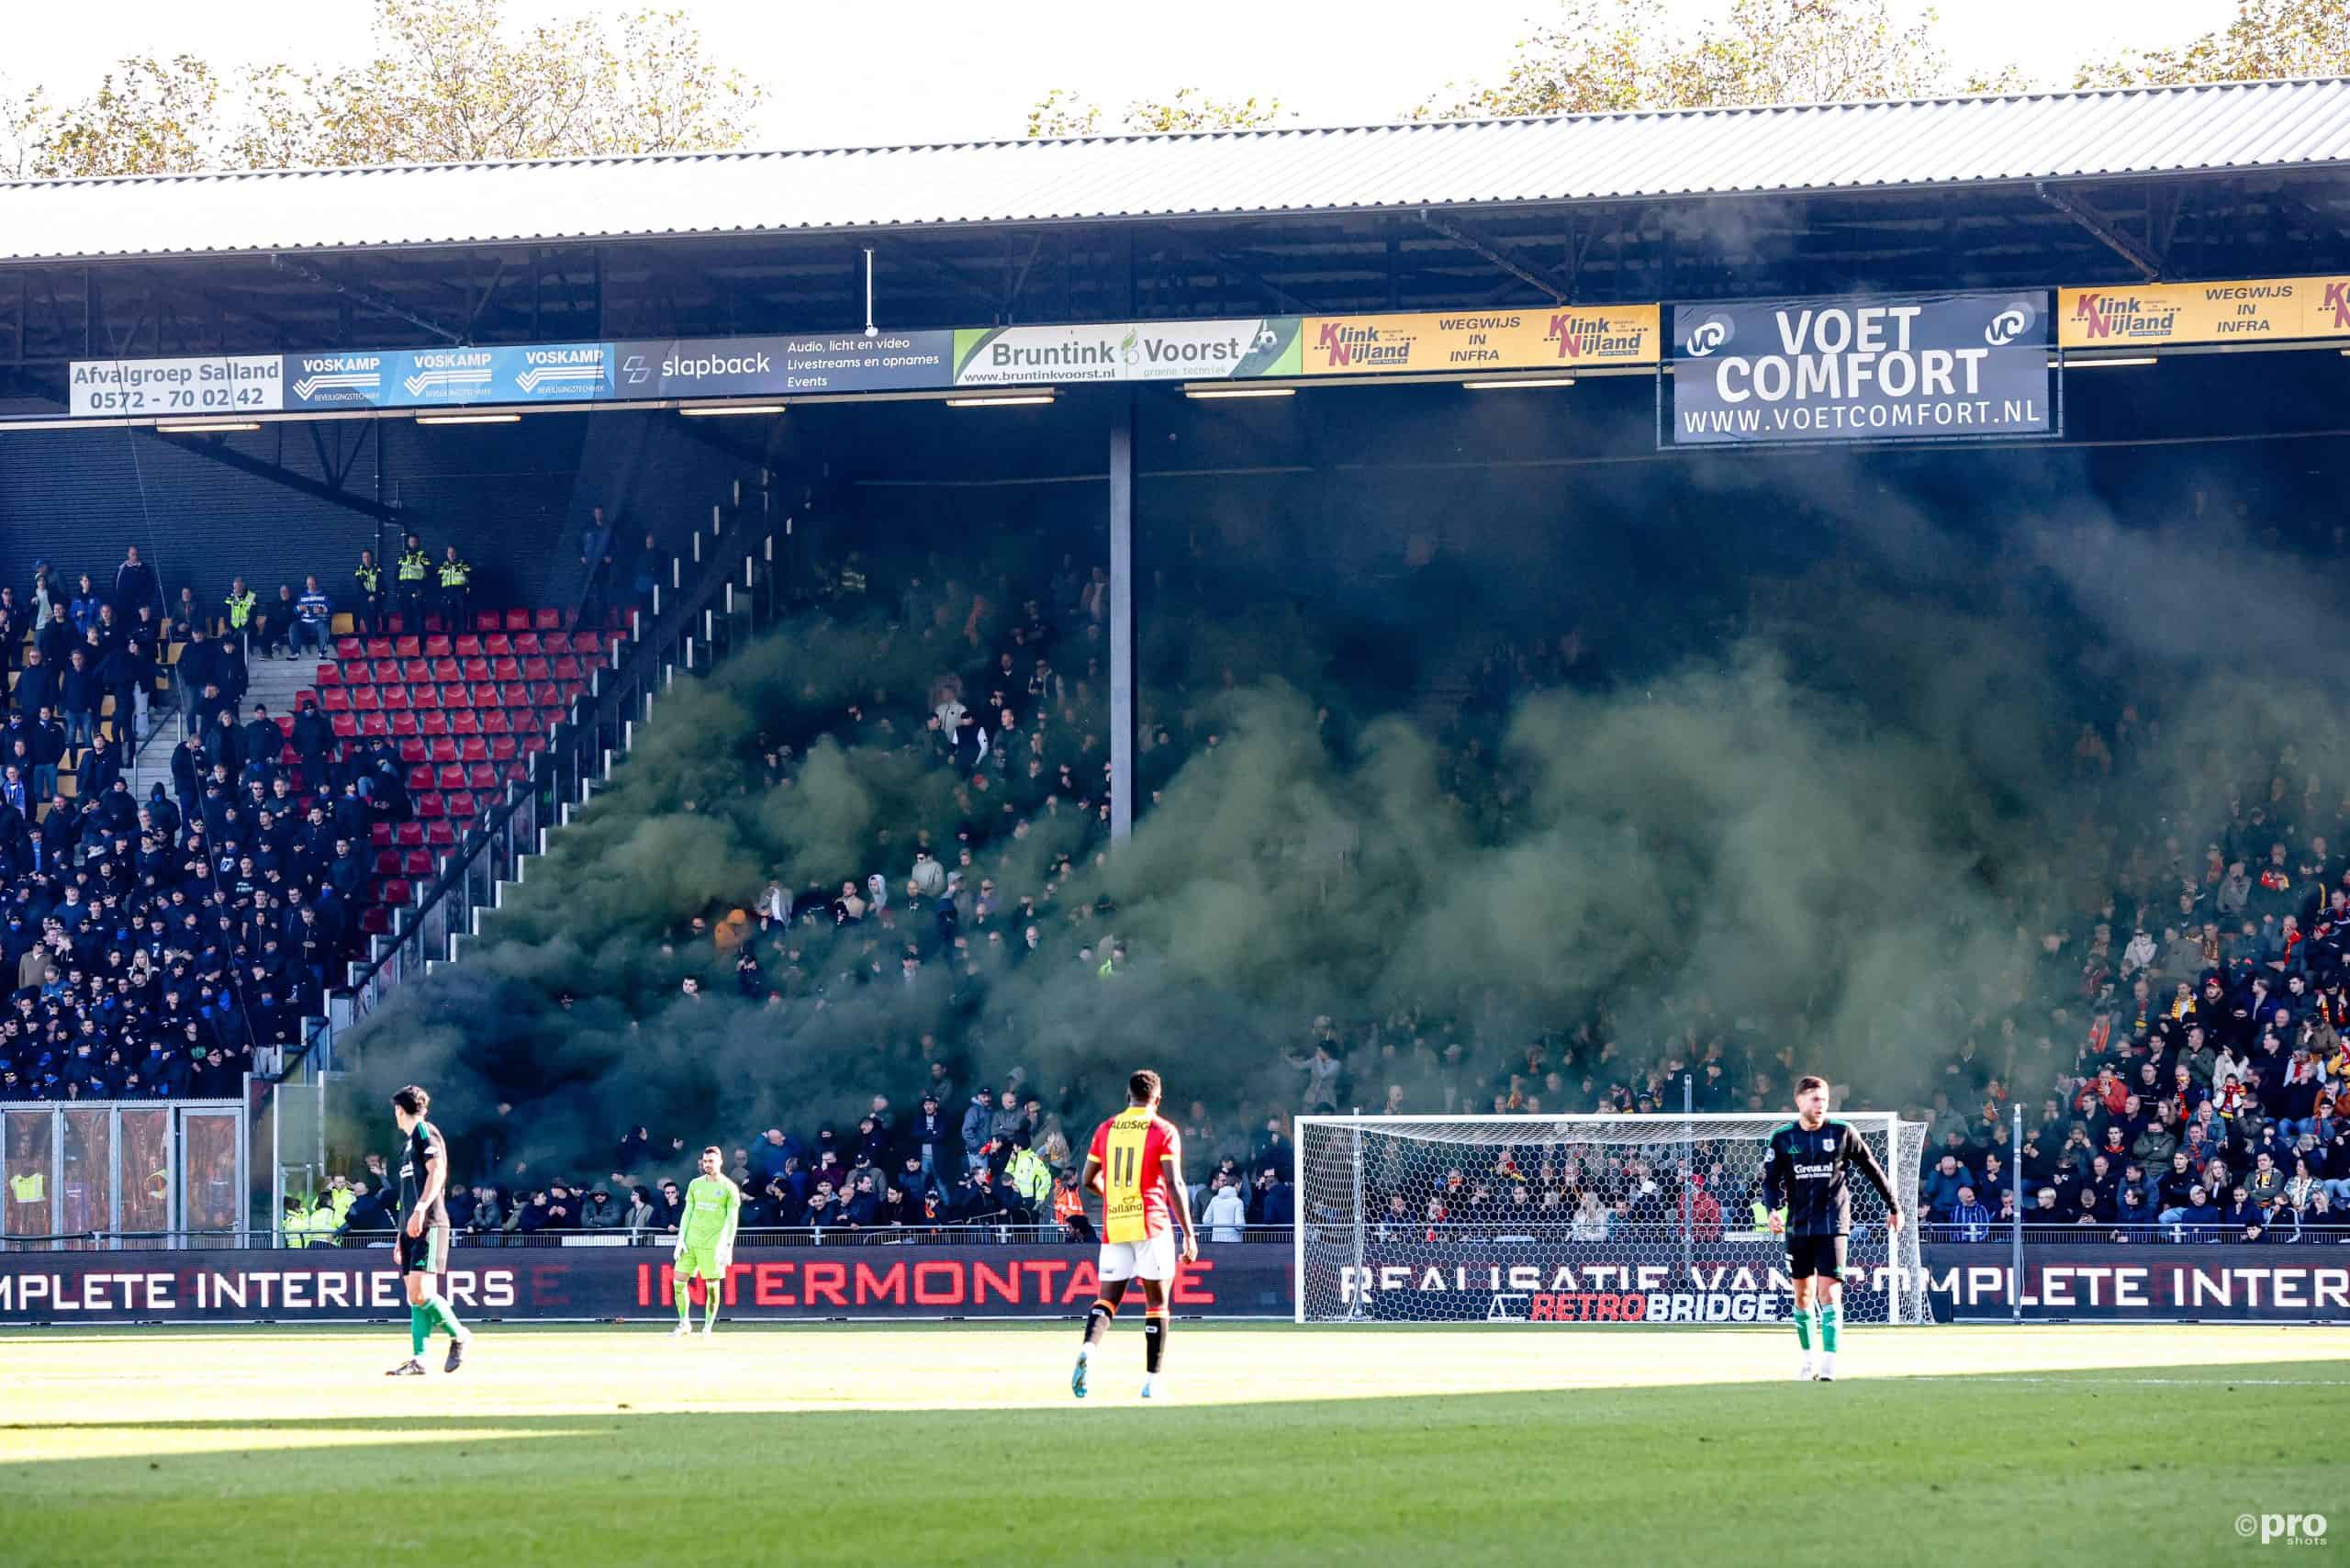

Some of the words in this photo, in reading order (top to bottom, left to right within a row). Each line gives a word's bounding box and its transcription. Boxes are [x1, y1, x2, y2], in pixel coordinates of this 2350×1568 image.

[2205, 286, 2293, 300] WEGWIJS
[2077, 294, 2142, 317] Klink
[2236, 304, 2255, 316] IN
[1320, 323, 1379, 345] Klink
[1439, 316, 1521, 331] WEGWIJS
[1550, 314, 1610, 337] Klink
[1775, 307, 1921, 356] VOET
[2087, 313, 2175, 339] Nijland
[2217, 320, 2270, 333] INFRA
[788, 342, 826, 353] Audio,
[829, 340, 854, 352] licht
[857, 341, 873, 350] en
[877, 338, 911, 349] video
[1469, 333, 1486, 345] IN
[1558, 333, 1641, 358] Nijland
[414, 353, 492, 368] VOSKAMP
[526, 349, 604, 364] VOSKAMP
[788, 358, 861, 370] Livestreams
[864, 358, 879, 367] en
[882, 355, 940, 367] opnames
[992, 340, 1115, 366] Bruntink
[1144, 337, 1240, 362] Voorst
[1328, 342, 1410, 366] Nijland
[1449, 349, 1499, 362] INFRA
[73, 365, 193, 386] Afvalgroep
[199, 362, 280, 382] Salland
[303, 357, 380, 373] VOSKAMP
[662, 353, 770, 379] slapback
[964, 368, 1116, 383] www.bruntinkvoorst.nl
[1716, 349, 1989, 402] COMFORT
[788, 375, 828, 387] Events
[90, 391, 144, 409] 0572
[169, 390, 194, 408] 70
[203, 389, 229, 407] 02
[236, 387, 263, 405] 42
[1684, 400, 2040, 434] WWW.VOETCOMFORT.NL
[1114, 1147, 1135, 1188] 11
[198, 1271, 514, 1307] INTERIERS
[2174, 1268, 2350, 1308] INTER
